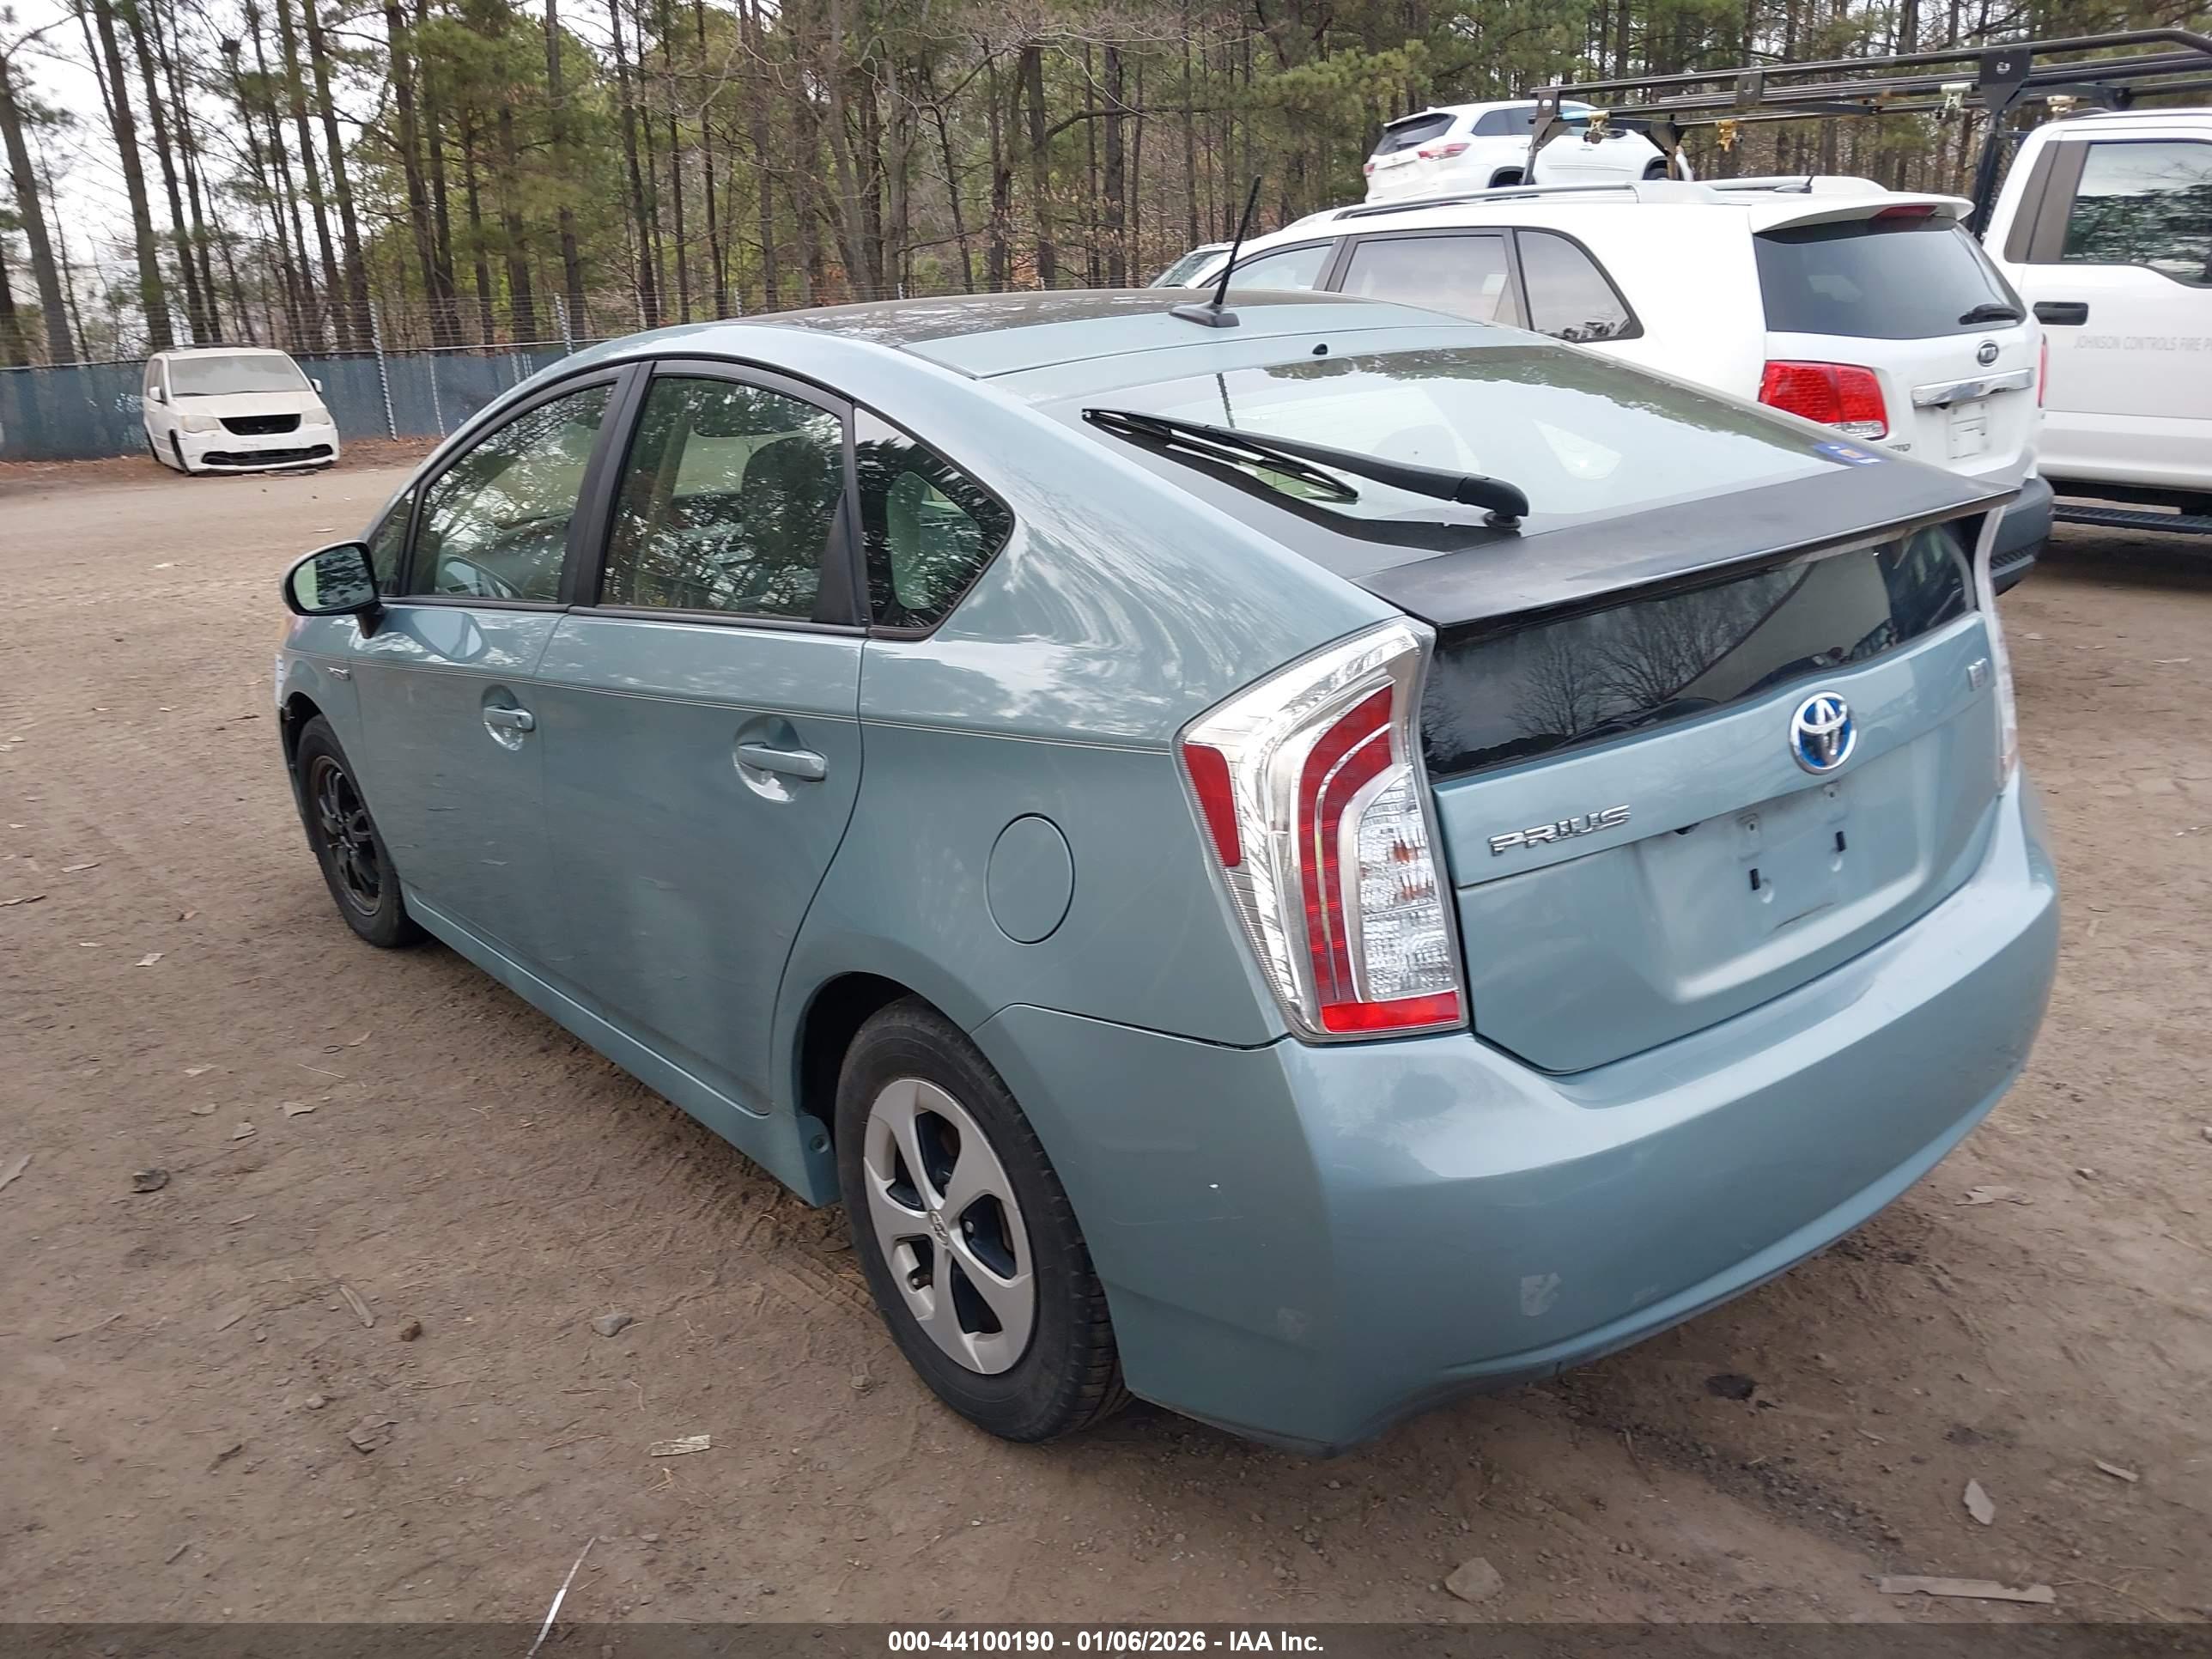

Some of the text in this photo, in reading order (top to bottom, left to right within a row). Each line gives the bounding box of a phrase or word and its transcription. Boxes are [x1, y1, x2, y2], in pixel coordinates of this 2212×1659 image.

[2074, 335, 2120, 349] JOHNSON
[2123, 336, 2177, 350] CONTROLS
[1488, 804, 1632, 857] PRIUS
